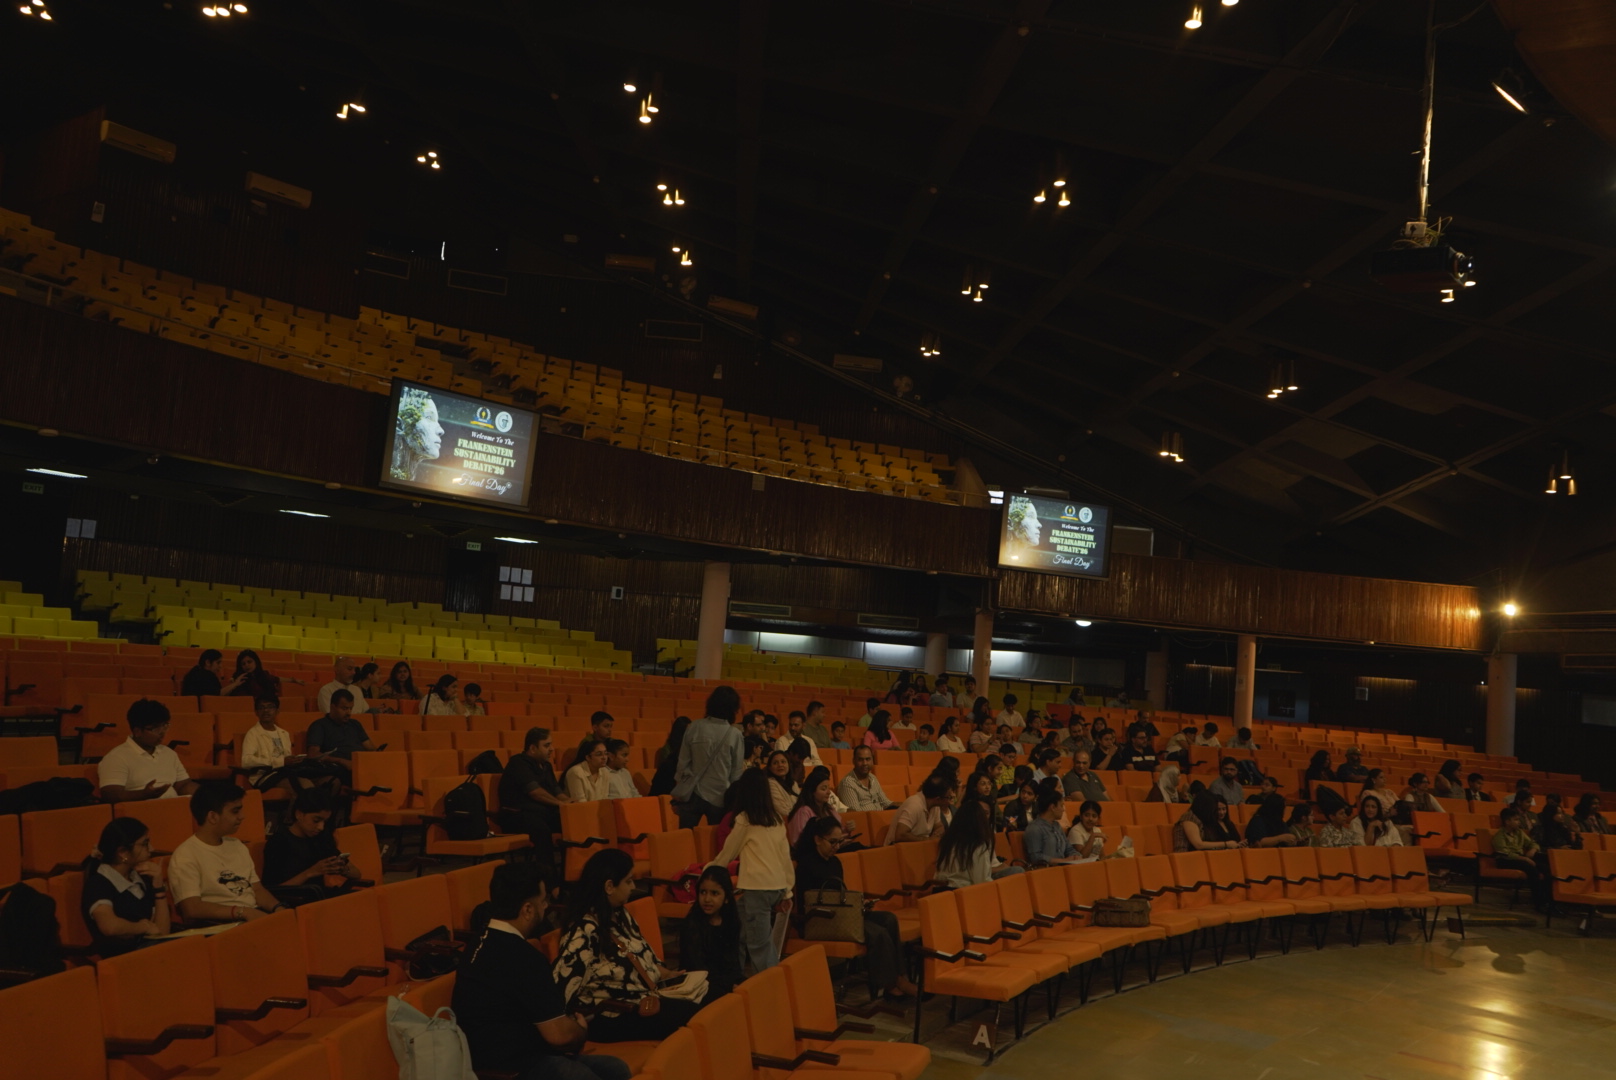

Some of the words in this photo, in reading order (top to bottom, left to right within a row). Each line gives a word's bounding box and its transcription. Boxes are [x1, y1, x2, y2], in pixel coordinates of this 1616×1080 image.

[472, 431, 495, 442] Welcome
[504, 438, 515, 446] The
[457, 438, 513, 458] FRANKENSTEIN
[453, 447, 516, 468] SUSTAINABILITY
[463, 459, 505, 475] DEBATE'26
[24, 484, 42, 492] EXIT
[458, 473, 485, 488] Final
[485, 478, 507, 495] Day
[1049, 536, 1096, 549] SUSTAINABILITY
[1052, 529, 1094, 541] FRANKENSTEIN
[972, 1024, 991, 1049] A
